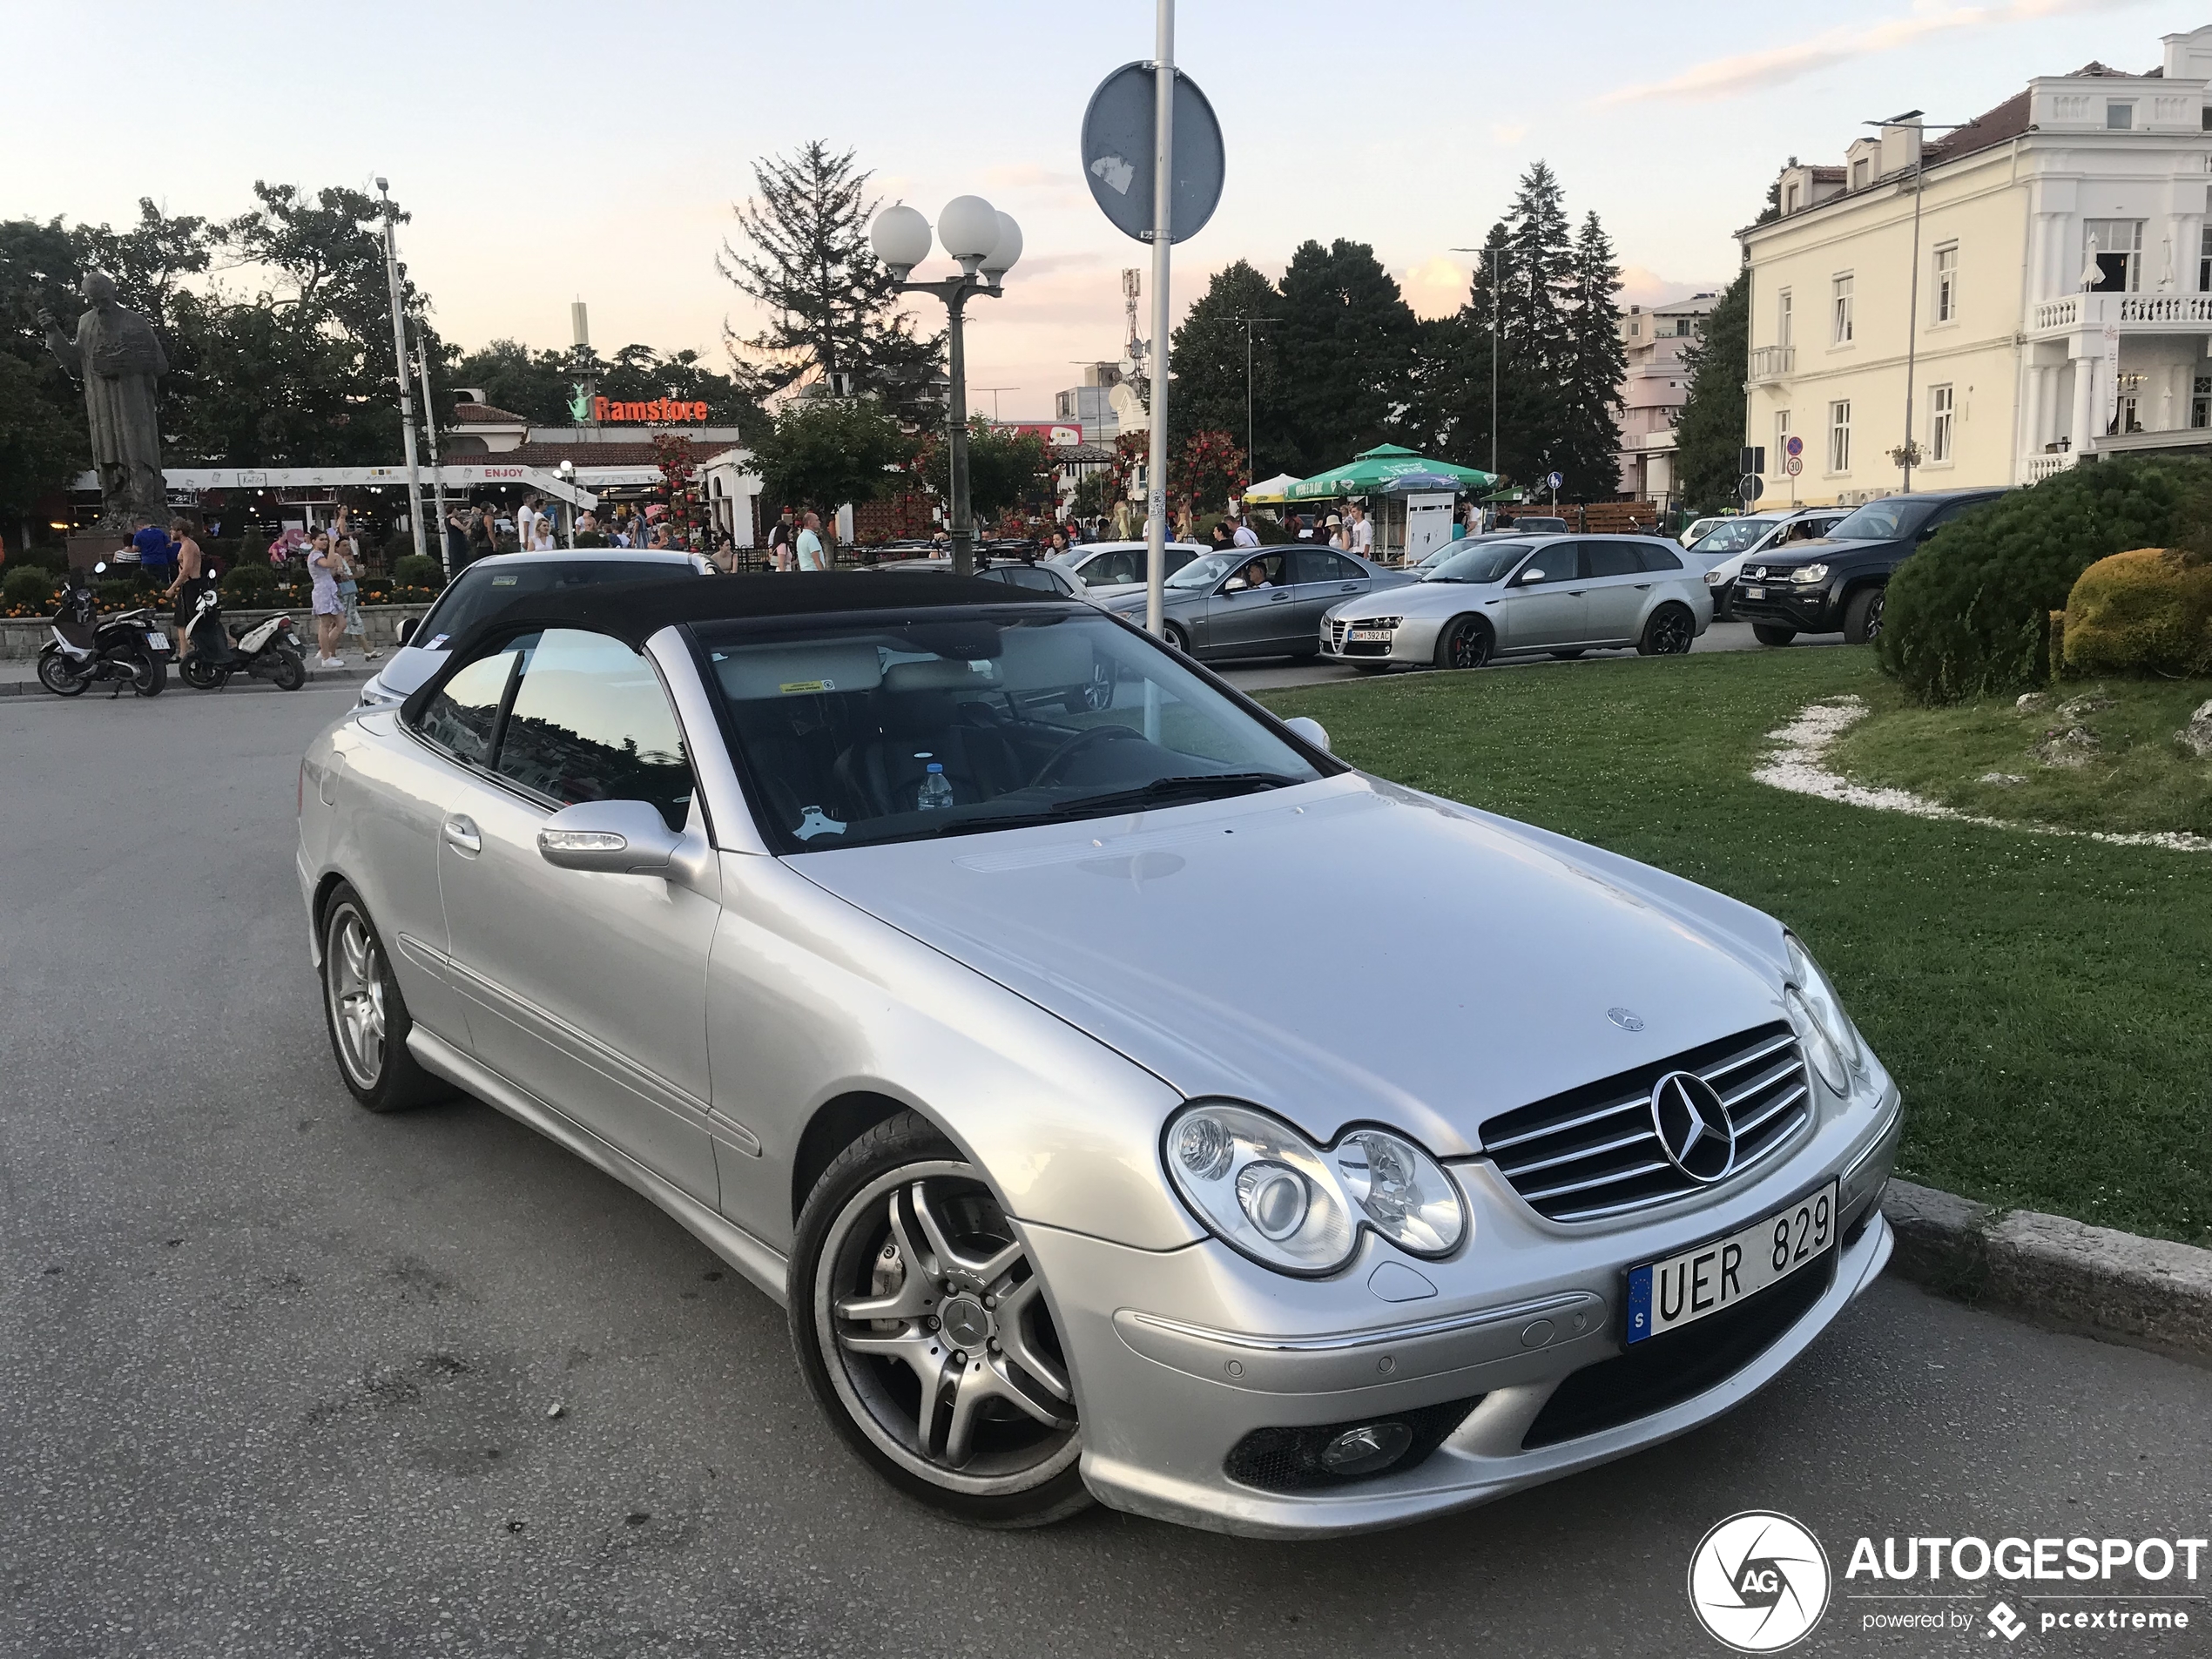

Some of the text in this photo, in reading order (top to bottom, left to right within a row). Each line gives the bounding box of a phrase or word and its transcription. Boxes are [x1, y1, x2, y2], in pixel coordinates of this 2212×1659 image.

[595, 396, 708, 421] Ramstore
[484, 469, 524, 478] ENJOY
[1790, 461, 1800, 472] 30
[1659, 1194, 1829, 1322] UER 829
[1635, 1312, 1644, 1328] S
